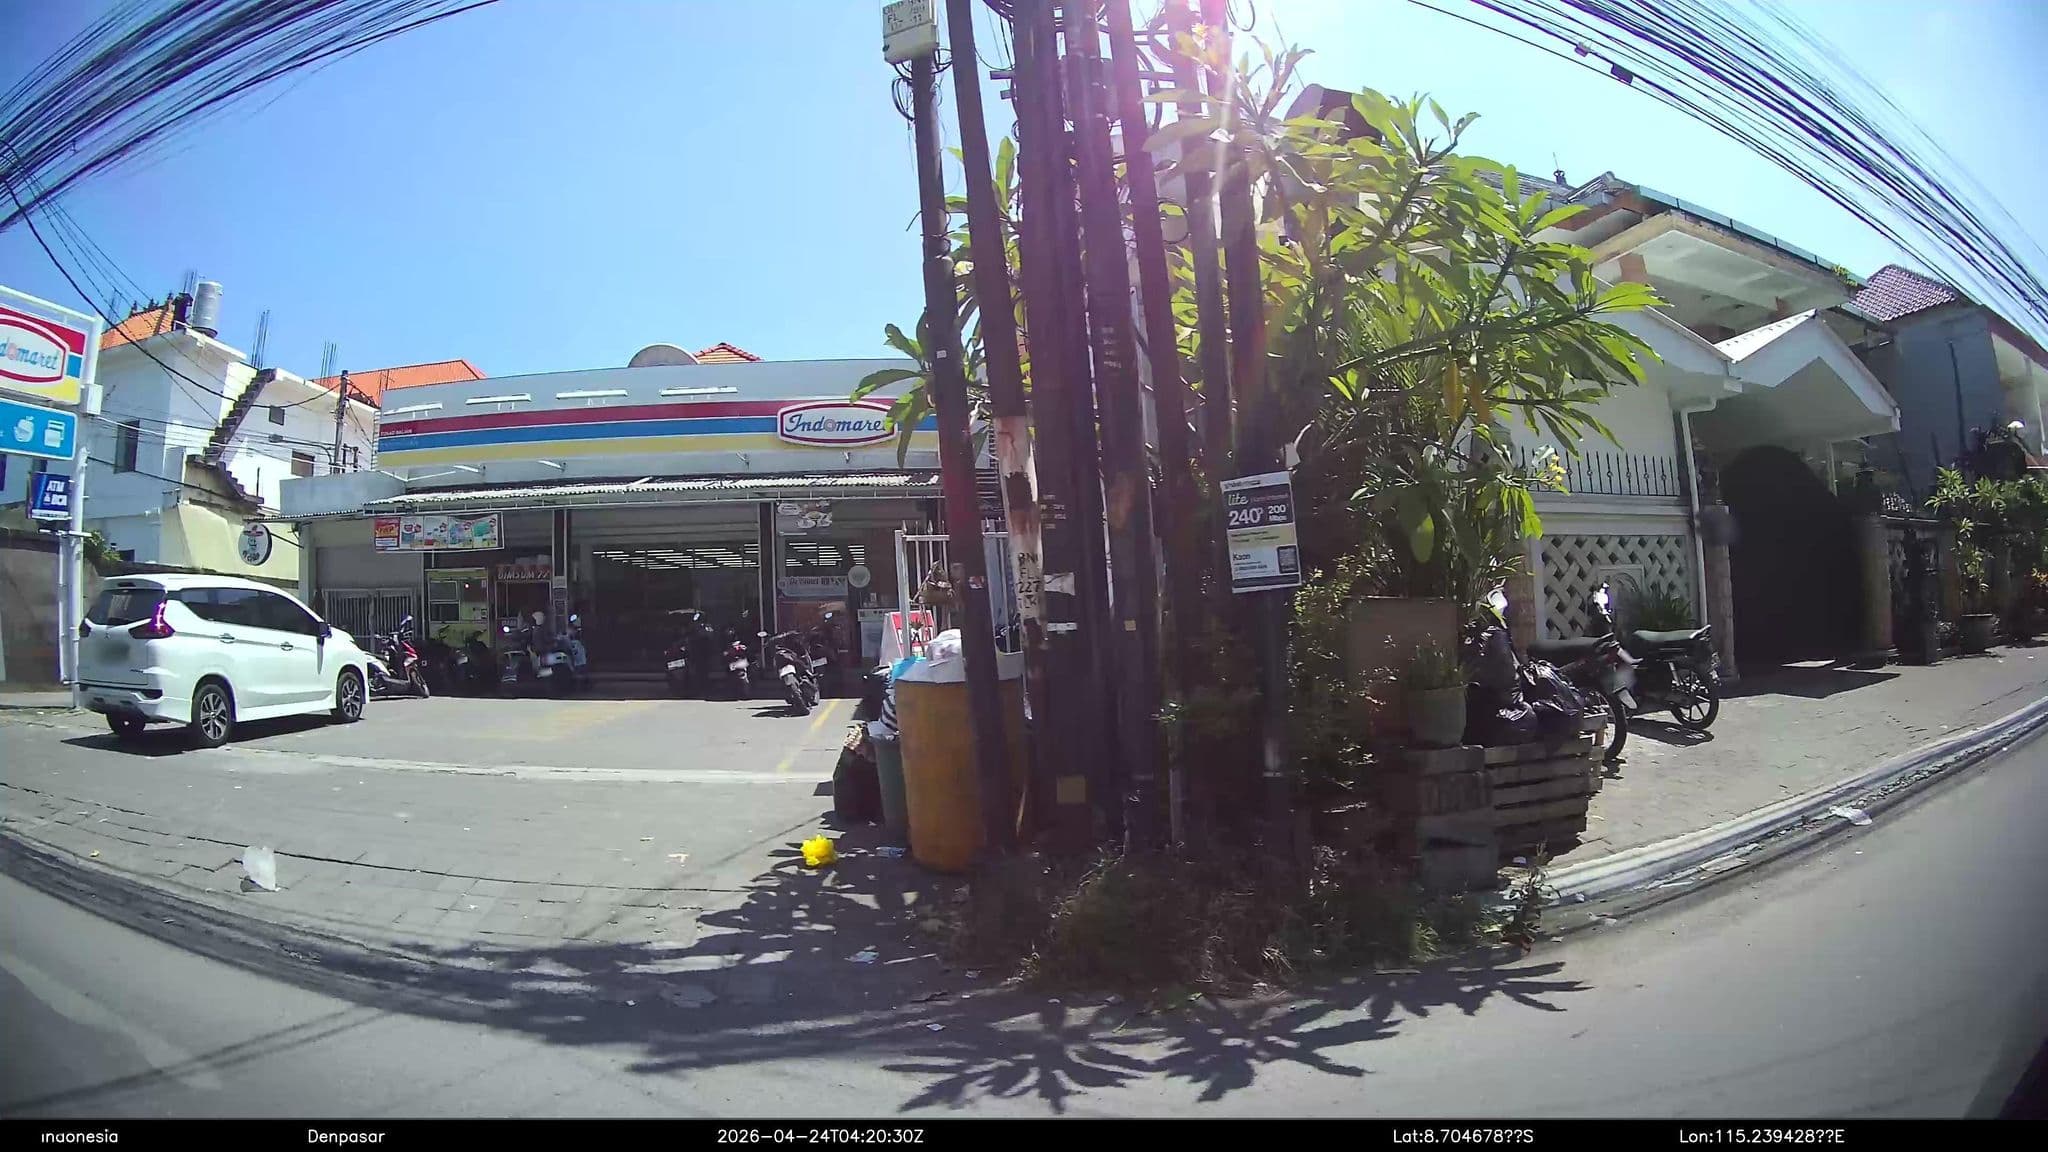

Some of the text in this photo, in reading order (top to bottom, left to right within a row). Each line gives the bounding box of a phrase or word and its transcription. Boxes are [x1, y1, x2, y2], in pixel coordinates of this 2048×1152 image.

[785, 413, 886, 433] Indomare
[46, 480, 65, 492] ATM
[1228, 493, 1249, 506] lite
[1267, 504, 1286, 514] 200
